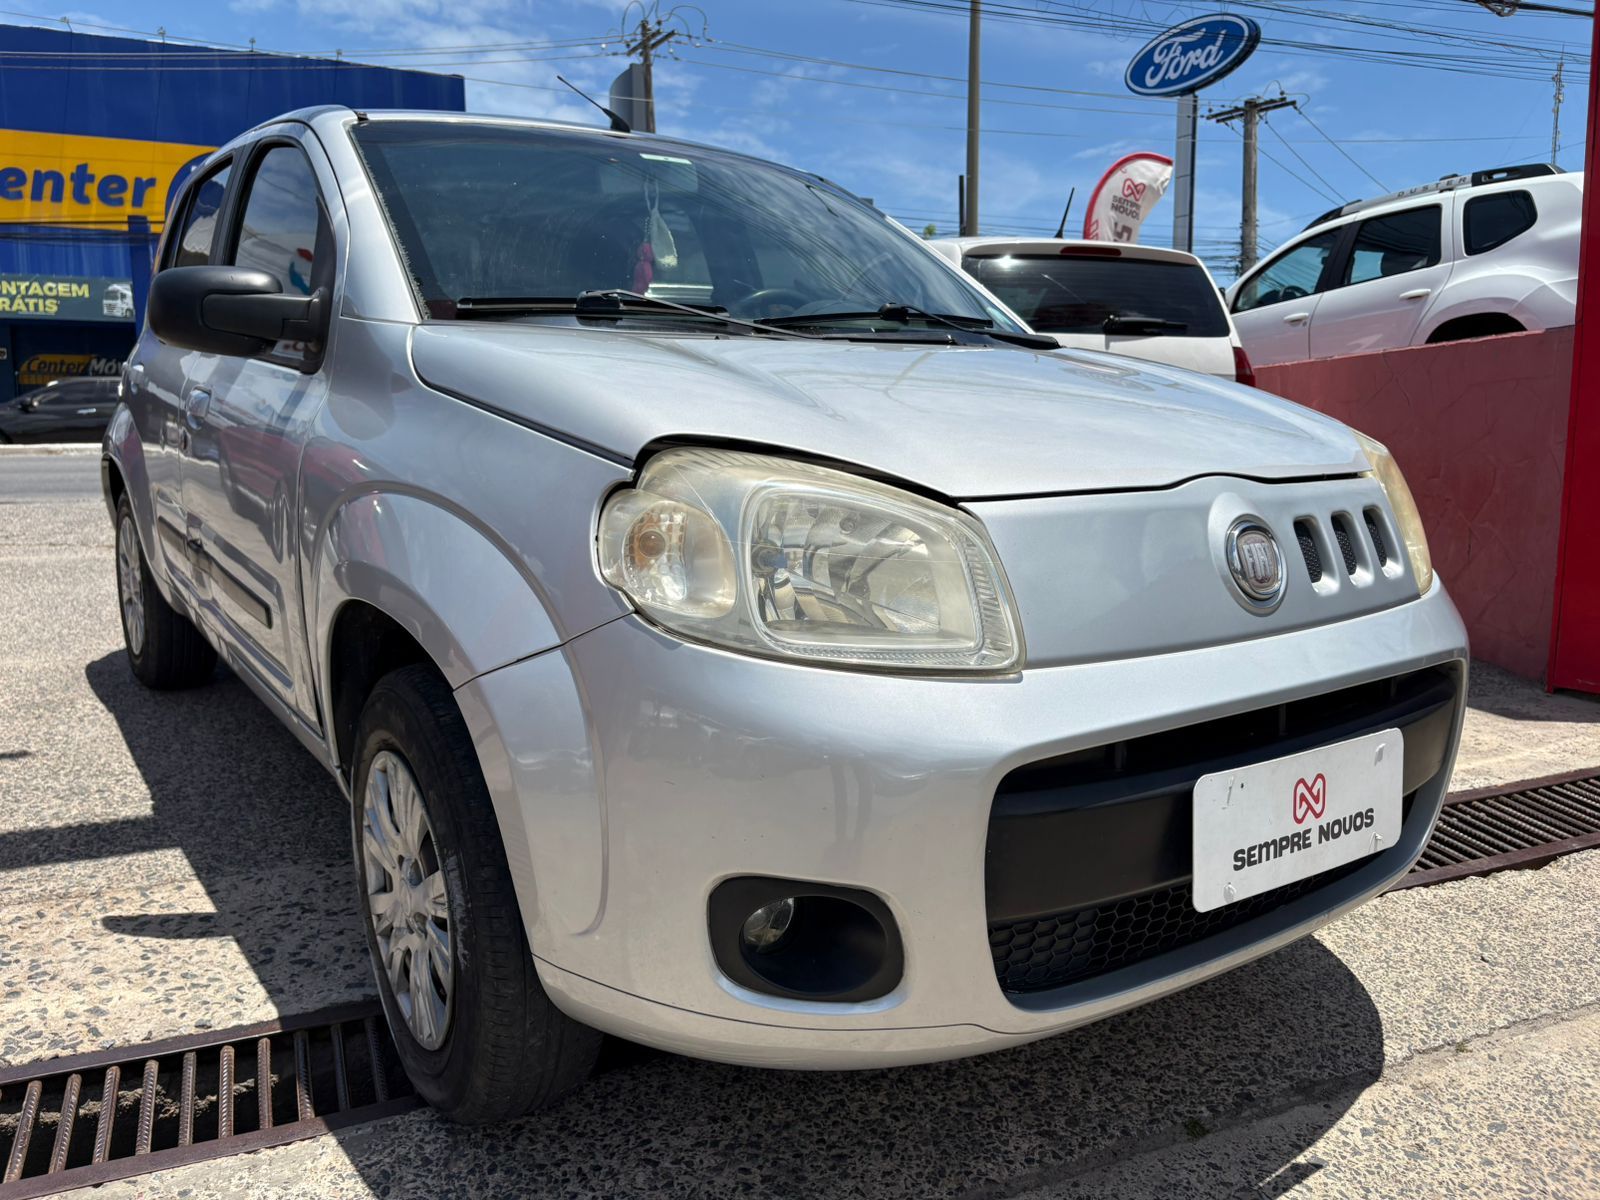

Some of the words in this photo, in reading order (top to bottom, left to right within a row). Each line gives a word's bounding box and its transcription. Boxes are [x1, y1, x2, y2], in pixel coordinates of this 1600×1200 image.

[1145, 28, 1226, 87] Ford
[0, 162, 157, 208] enter
[1397, 176, 1467, 198] DUSTER
[0, 281, 90, 298] NTAGEM
[0, 294, 58, 312] RÁTIS
[27, 358, 86, 376] Center
[1233, 828, 1312, 871] SEMPRE
